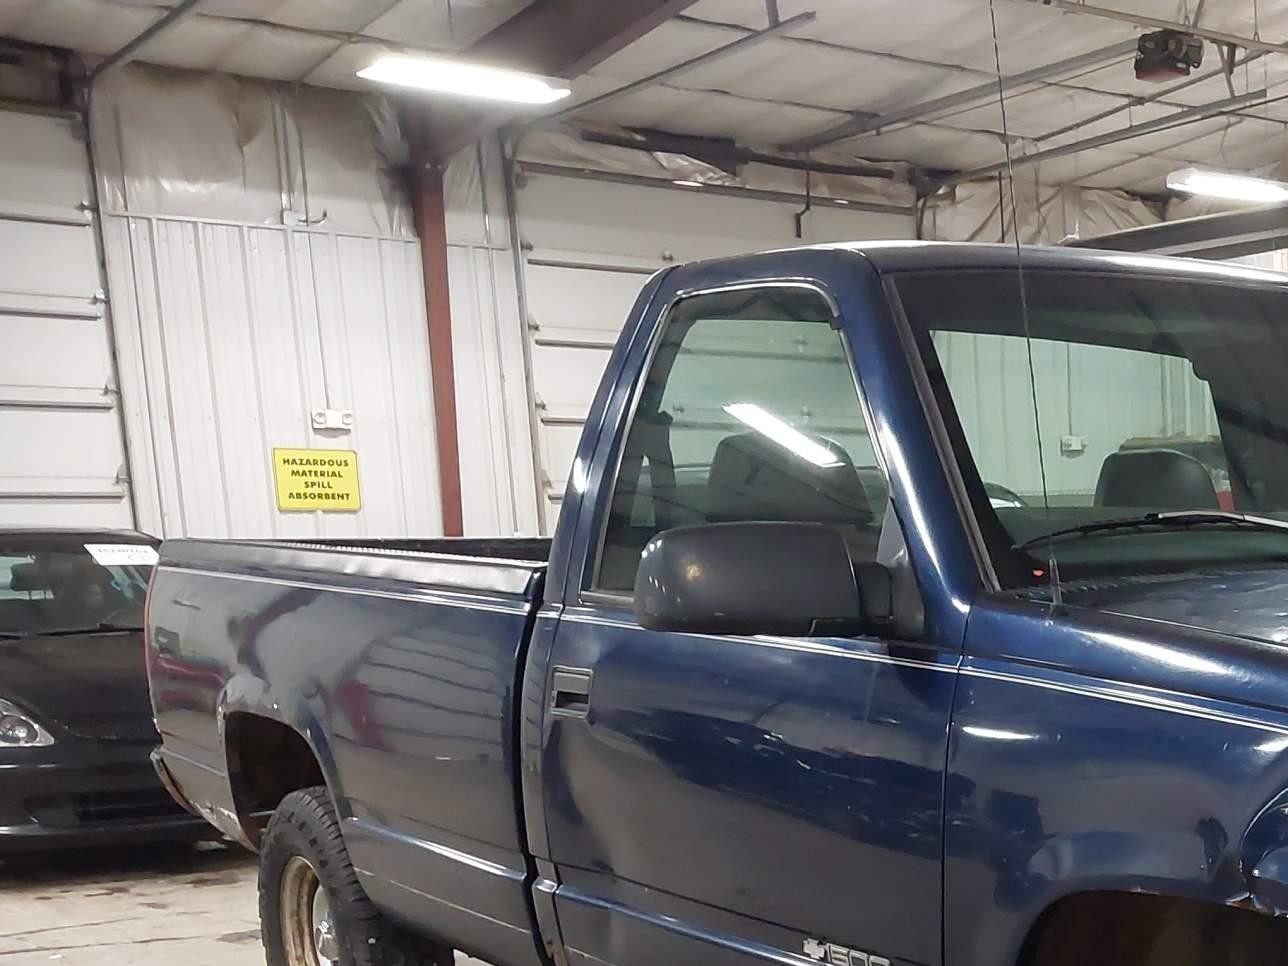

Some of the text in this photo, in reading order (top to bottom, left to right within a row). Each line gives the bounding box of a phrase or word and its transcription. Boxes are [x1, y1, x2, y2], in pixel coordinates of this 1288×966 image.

[282, 457, 349, 468] HAZARDOUS
[290, 469, 344, 479] MATERIAL
[304, 480, 333, 489] SPILL
[288, 491, 351, 501] ABSORBENT
